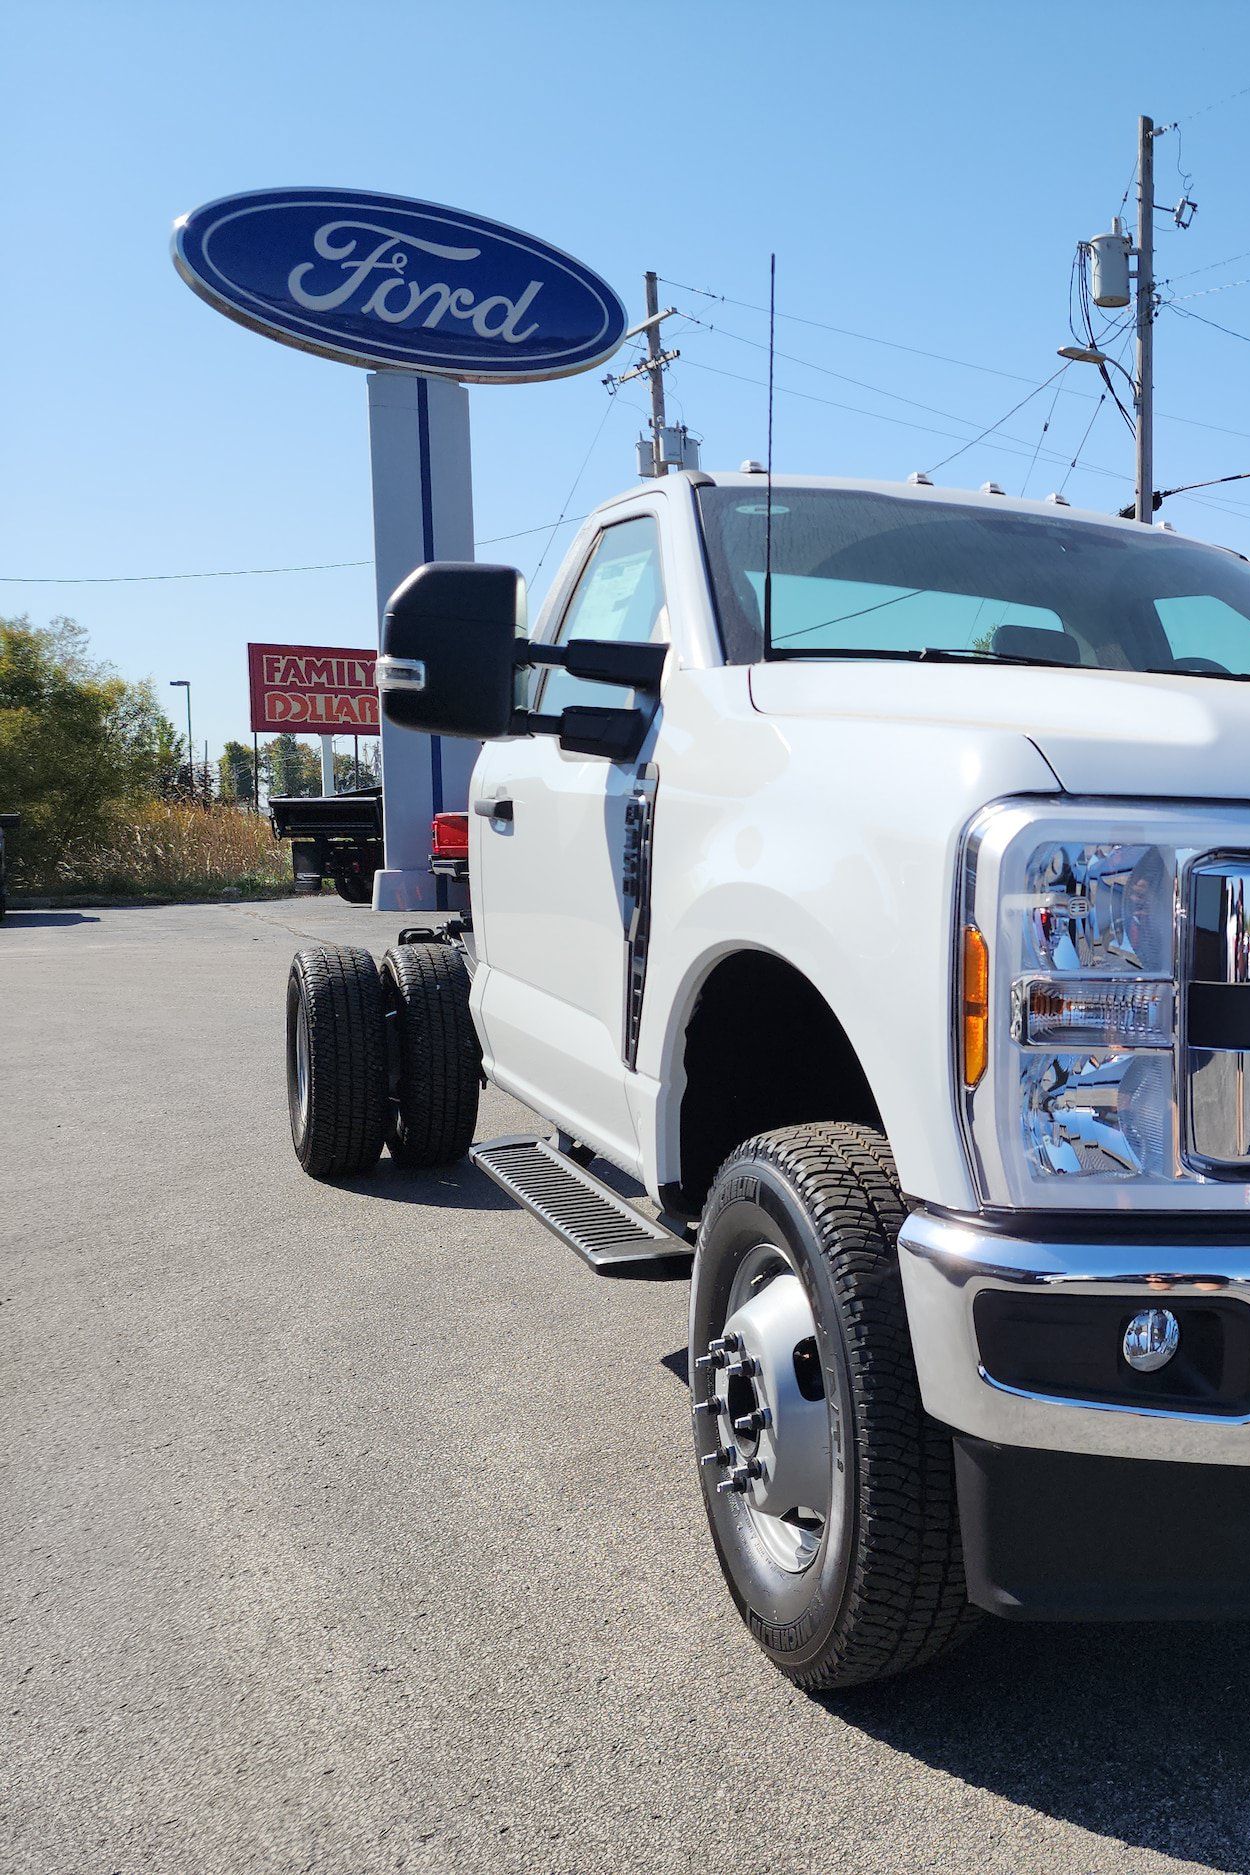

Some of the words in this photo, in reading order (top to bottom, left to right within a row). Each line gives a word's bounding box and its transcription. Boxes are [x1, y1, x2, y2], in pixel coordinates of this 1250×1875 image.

[288, 220, 544, 343] Ford
[263, 655, 377, 689] FAMILY
[265, 691, 379, 725] DOLLAR
